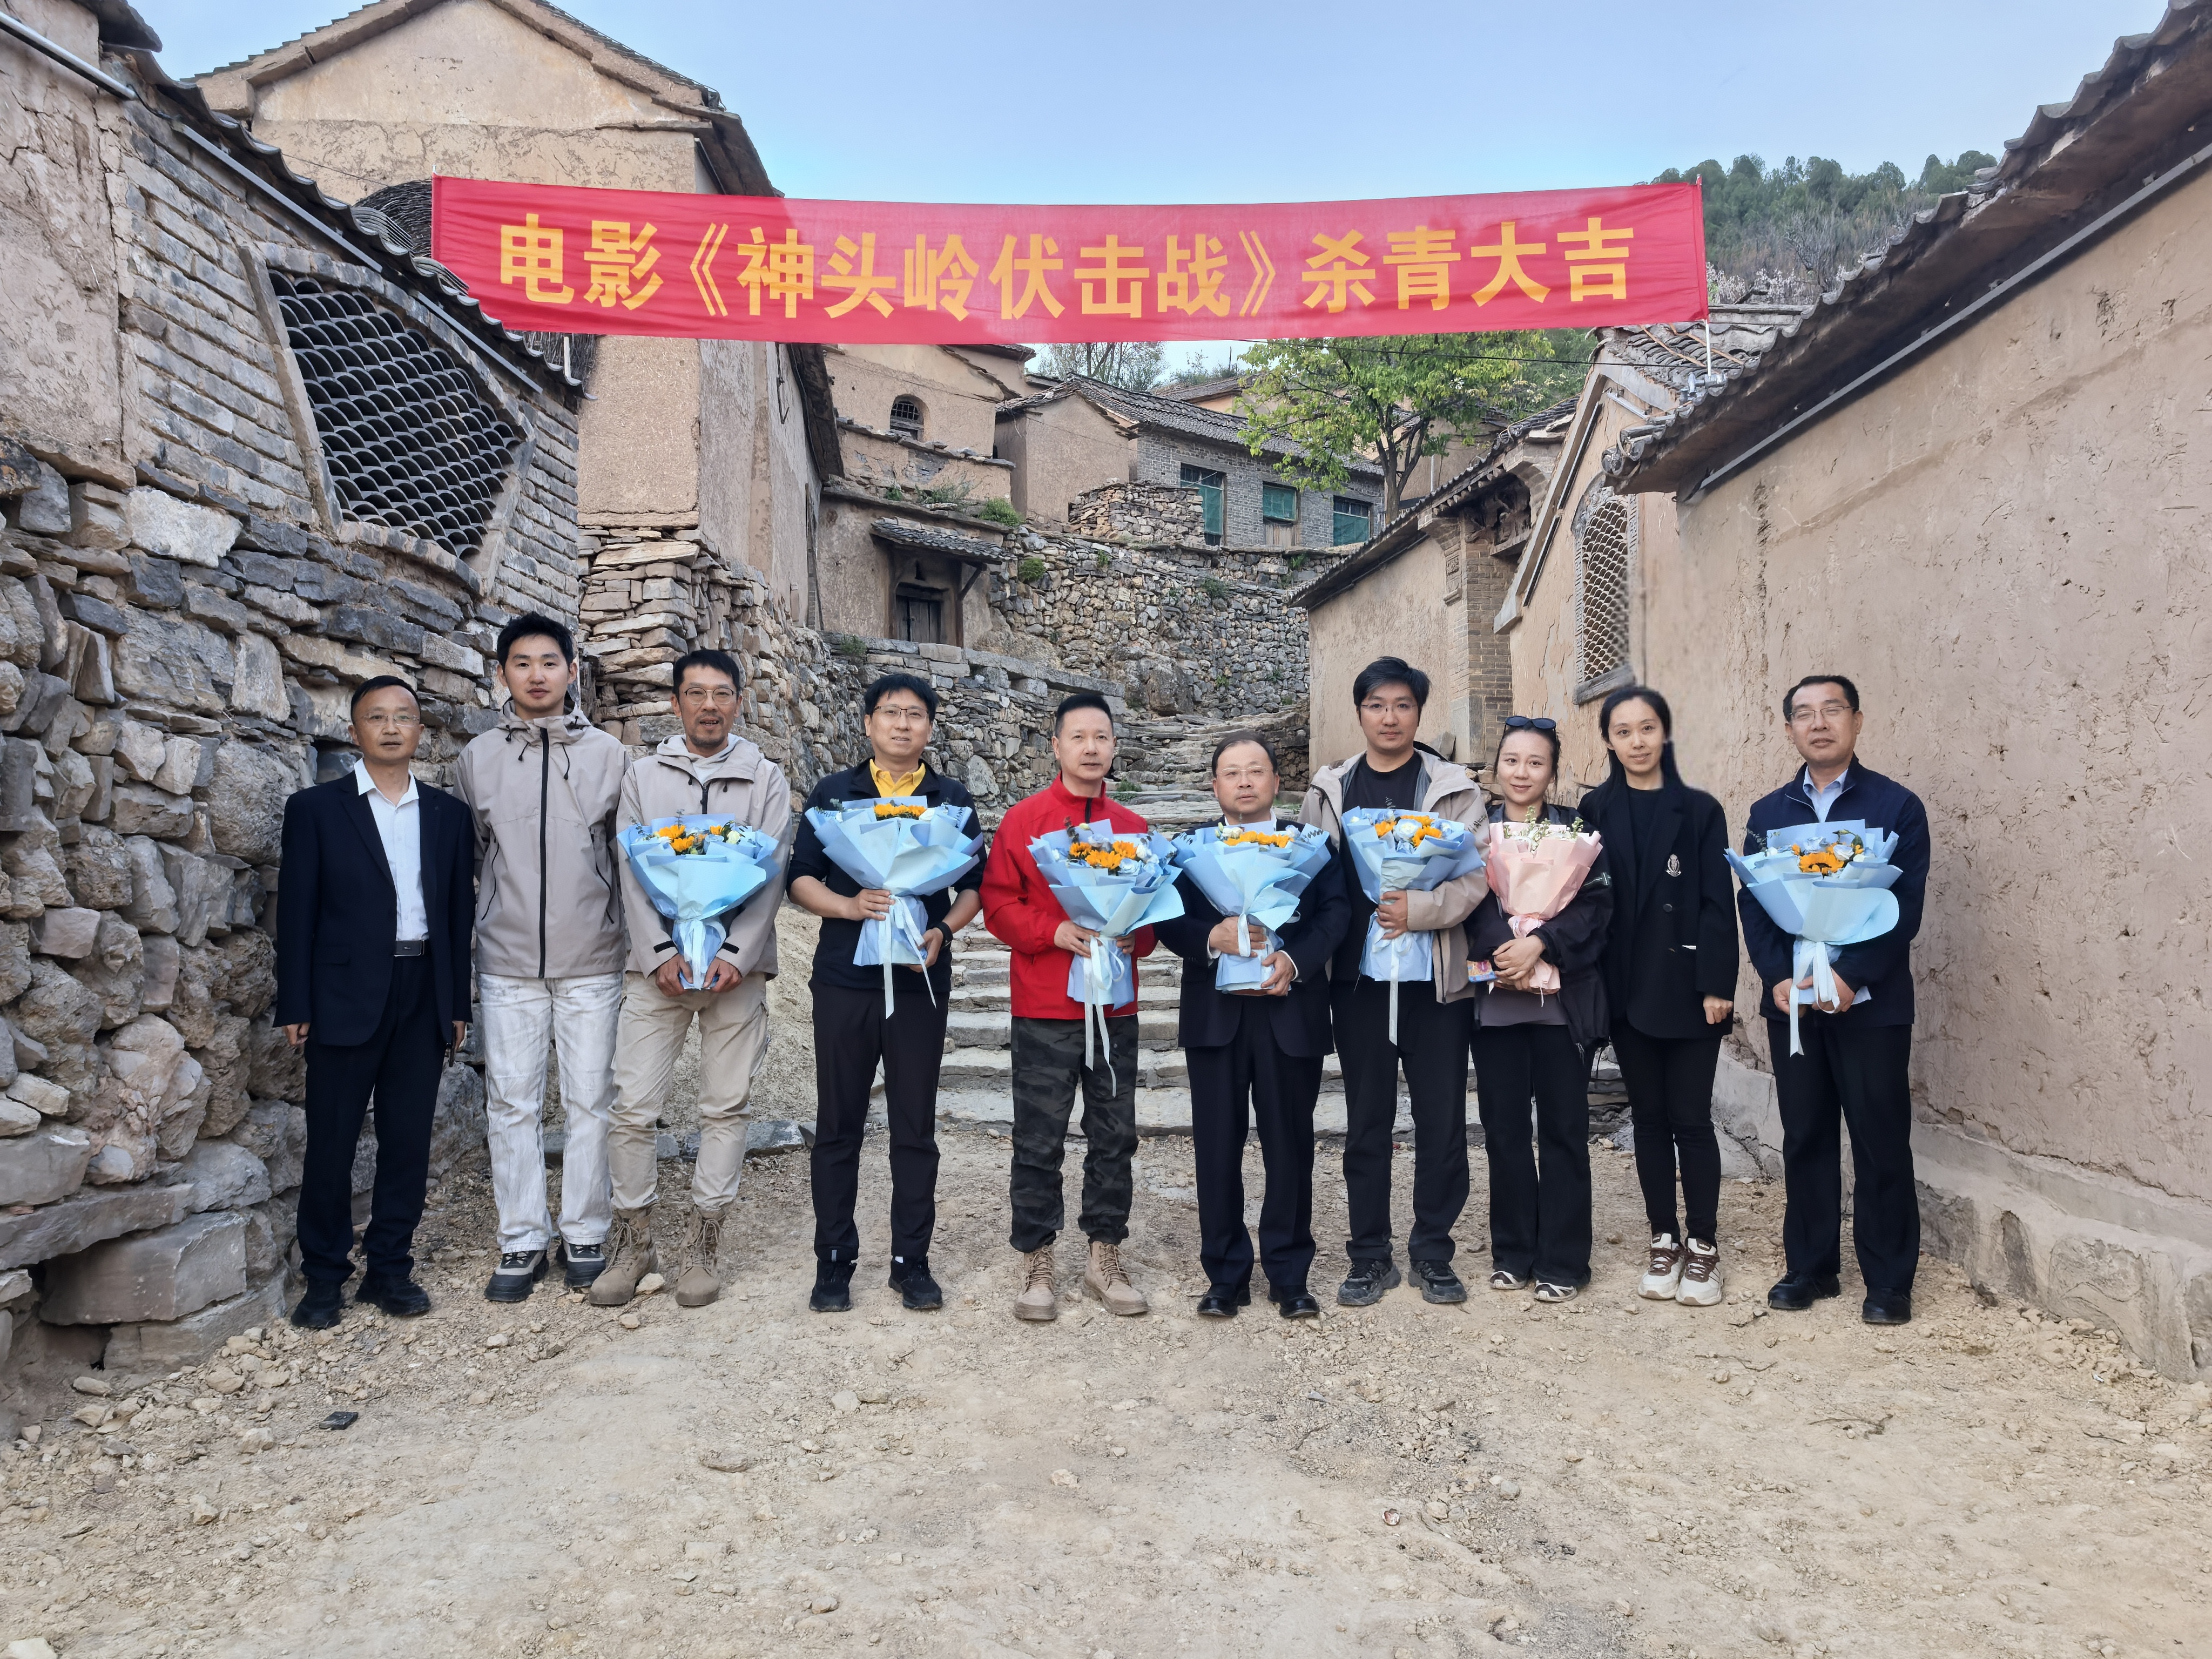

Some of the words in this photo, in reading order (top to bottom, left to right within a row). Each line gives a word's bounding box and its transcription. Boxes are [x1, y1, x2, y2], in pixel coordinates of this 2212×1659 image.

[501, 213, 1634, 321] 电影《神头岭伏击战》杀青大吉
